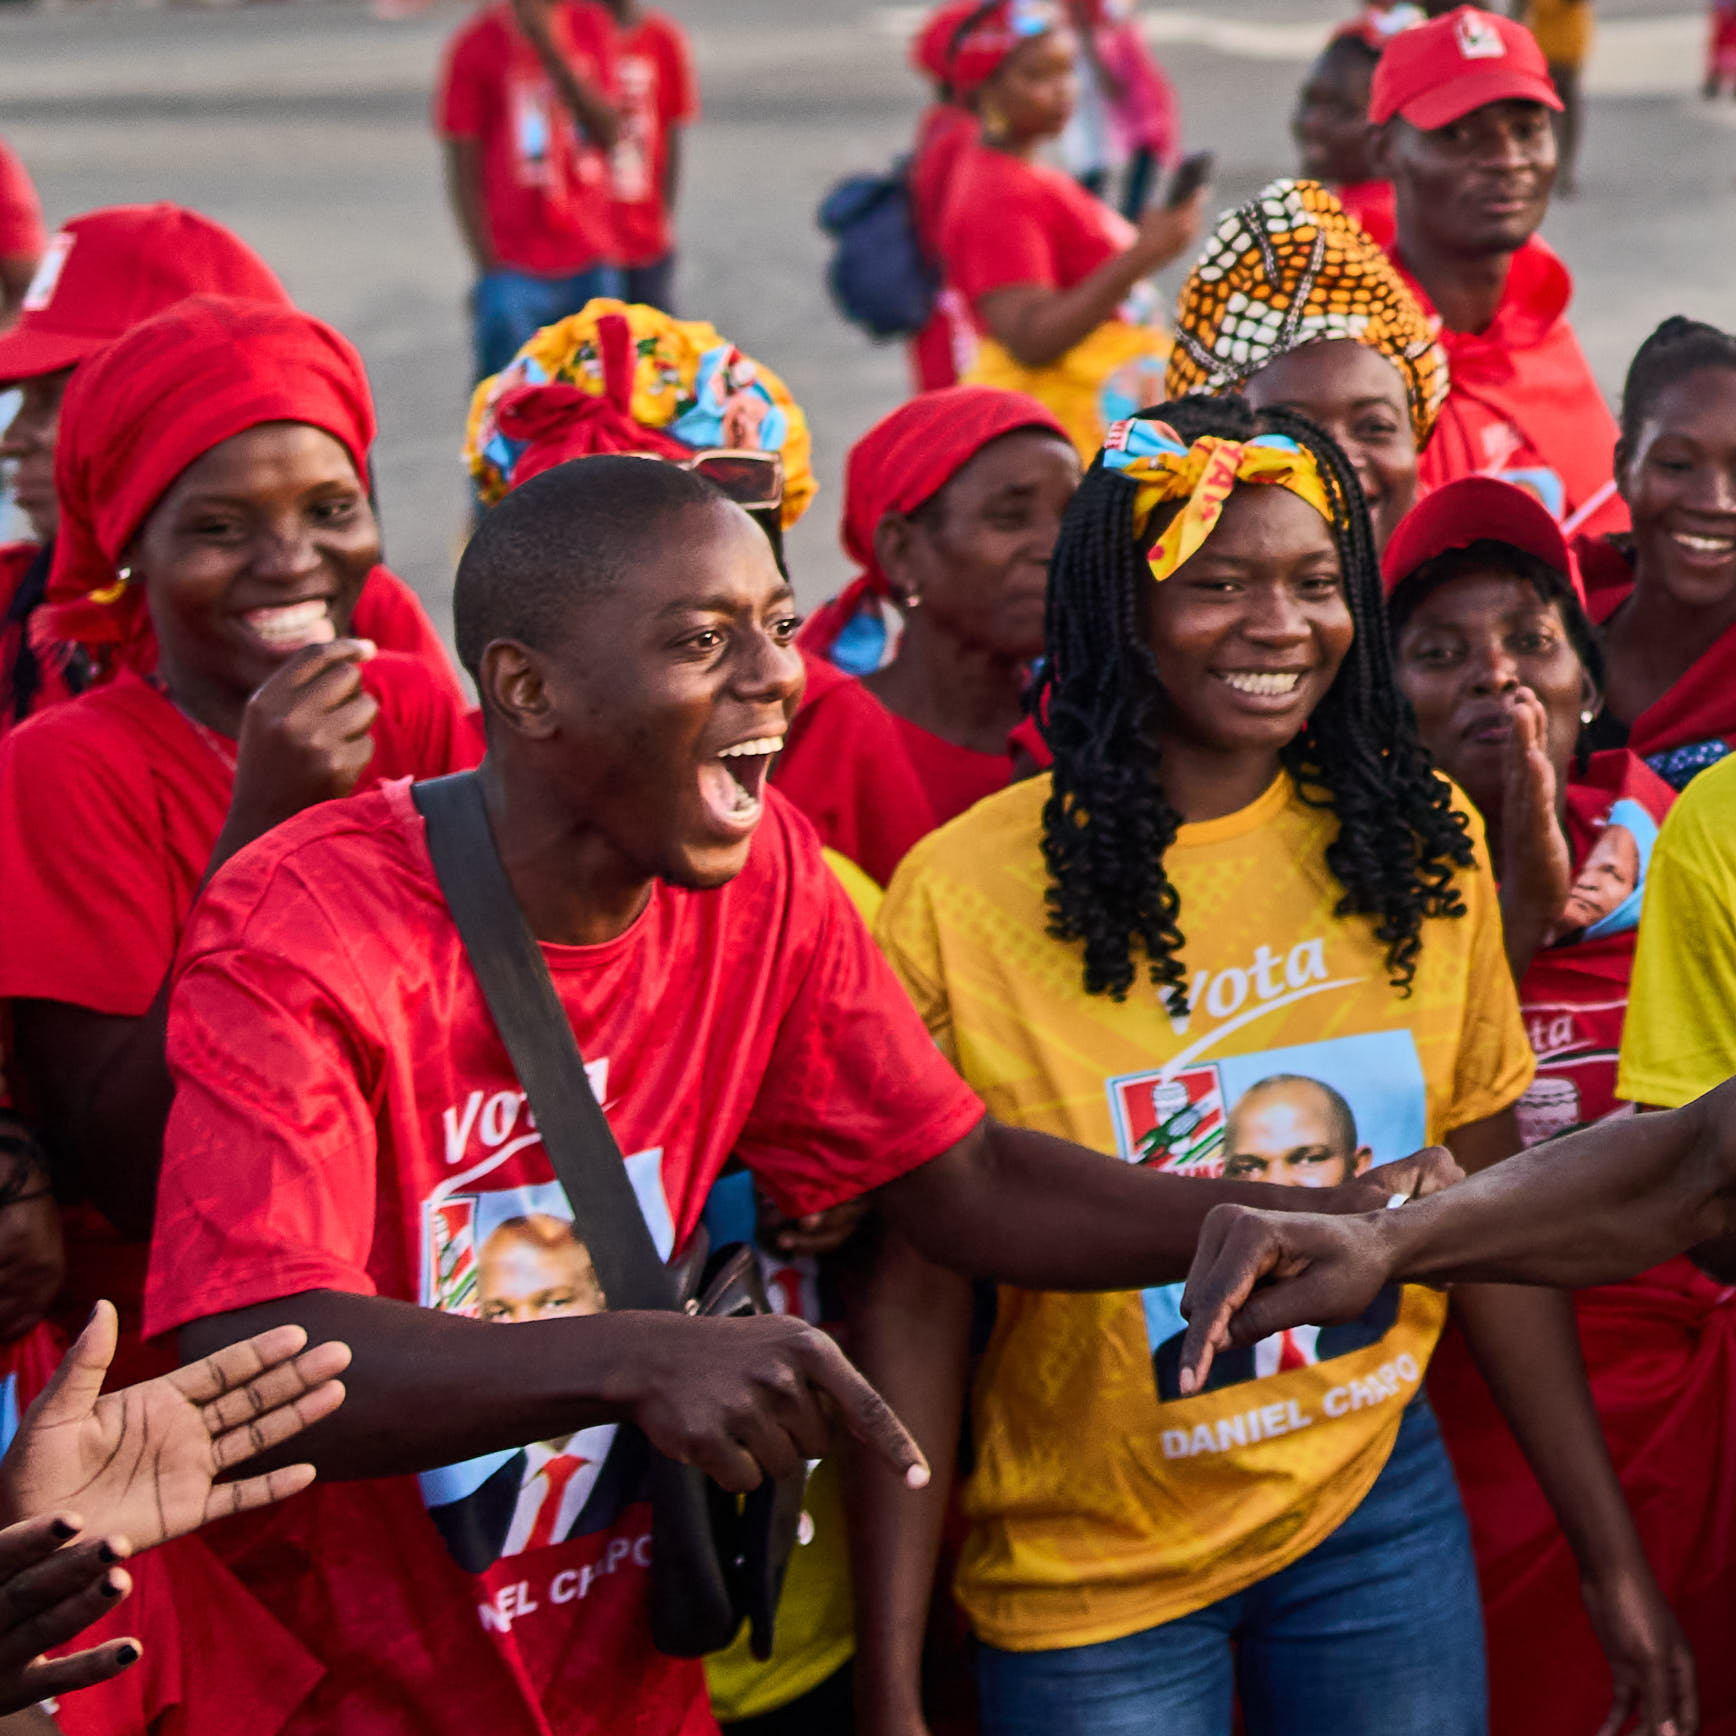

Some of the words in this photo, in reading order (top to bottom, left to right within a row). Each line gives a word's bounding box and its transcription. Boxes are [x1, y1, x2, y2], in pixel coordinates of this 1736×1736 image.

[1530, 1015, 1573, 1052] ta
[1160, 1398, 1312, 1459] DANIEL
[1323, 1353, 1419, 1417] CHAPO
